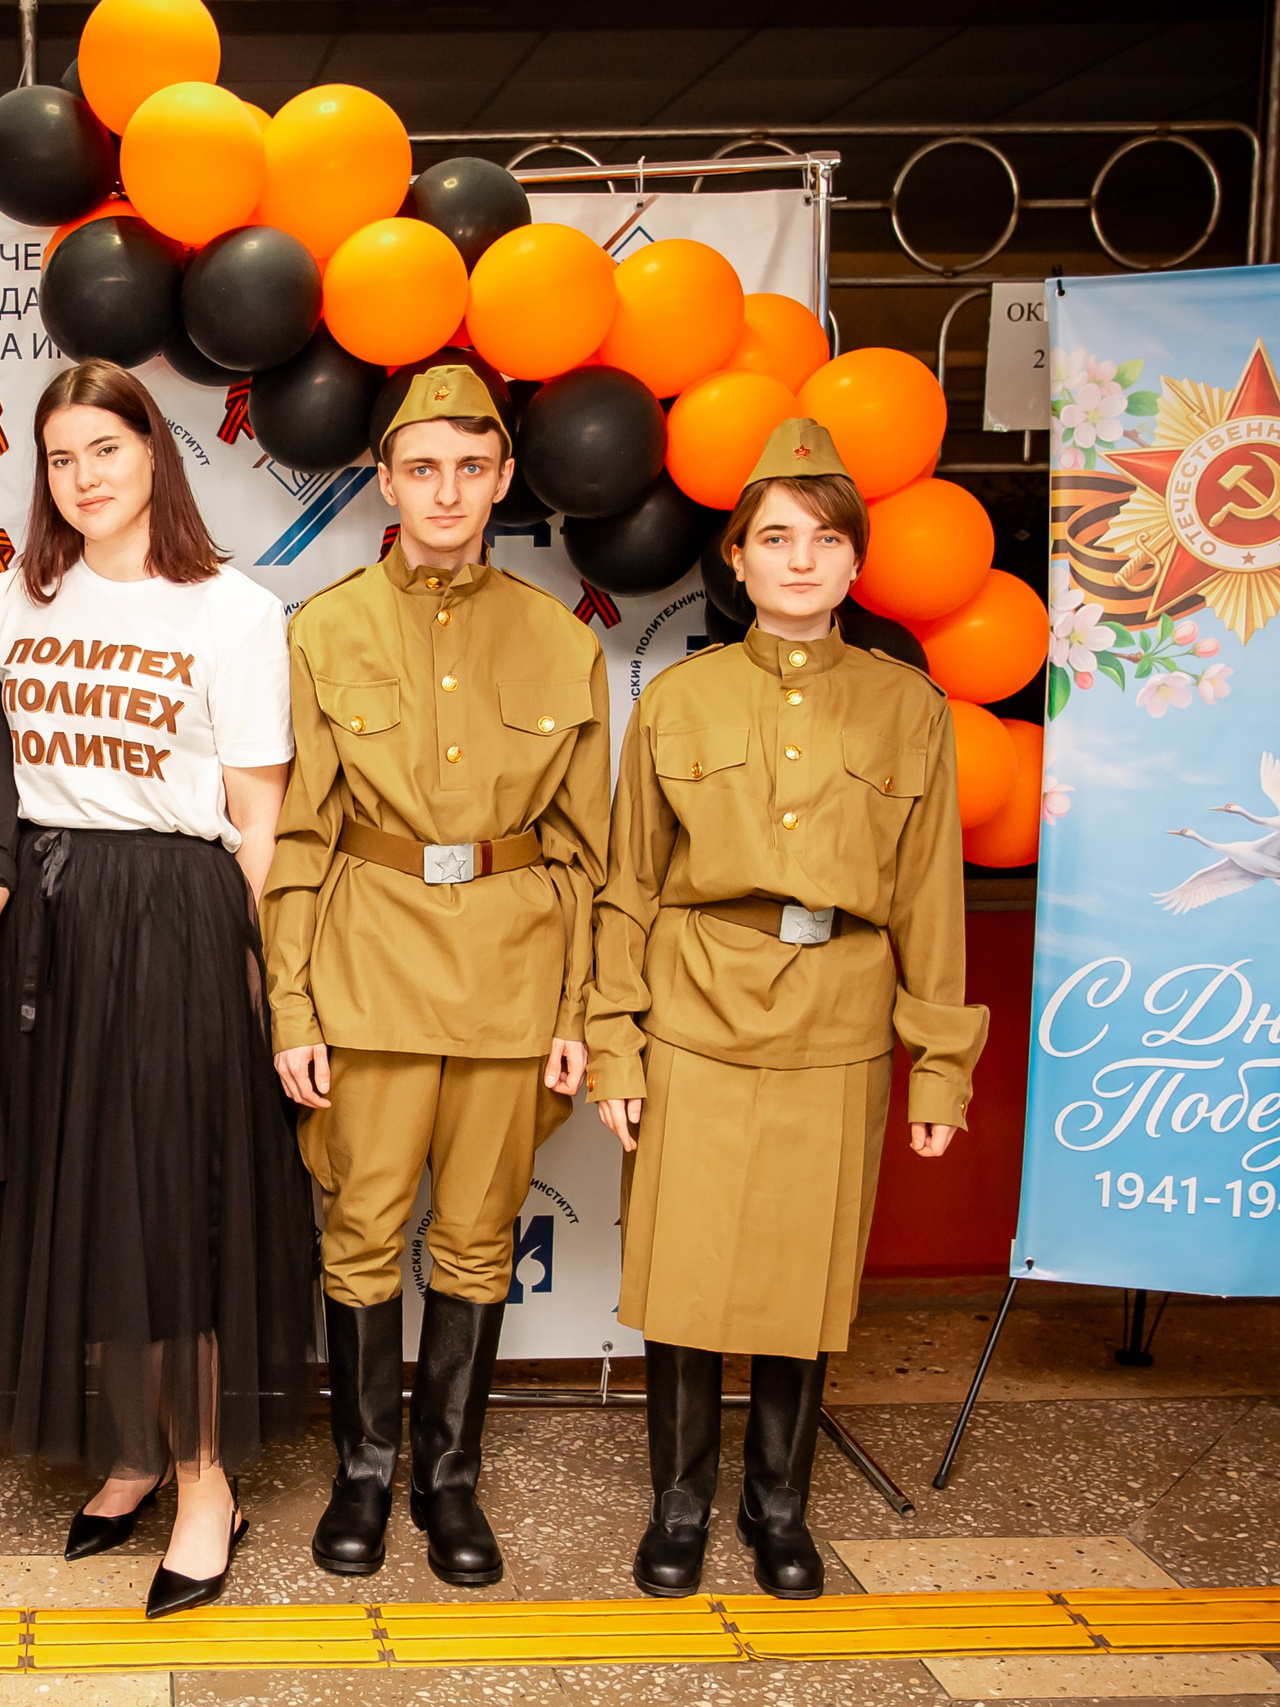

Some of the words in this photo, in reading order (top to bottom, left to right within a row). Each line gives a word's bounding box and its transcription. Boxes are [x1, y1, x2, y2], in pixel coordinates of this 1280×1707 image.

[1007, 302, 1043, 323] ОК
[164, 417, 210, 466] НСТИТУТ
[635, 589, 708, 656] ПОЛИТЕХНИЧ
[3, 636, 196, 689] ПОЛИТЕХ
[2, 677, 186, 736] ПОЛИТЕХ
[1038, 956, 1132, 1058] С
[1054, 1056, 1280, 1173] Побе
[529, 1177, 580, 1226] ИНСТИТУТ
[1094, 1170, 1280, 1220] 1941-19
